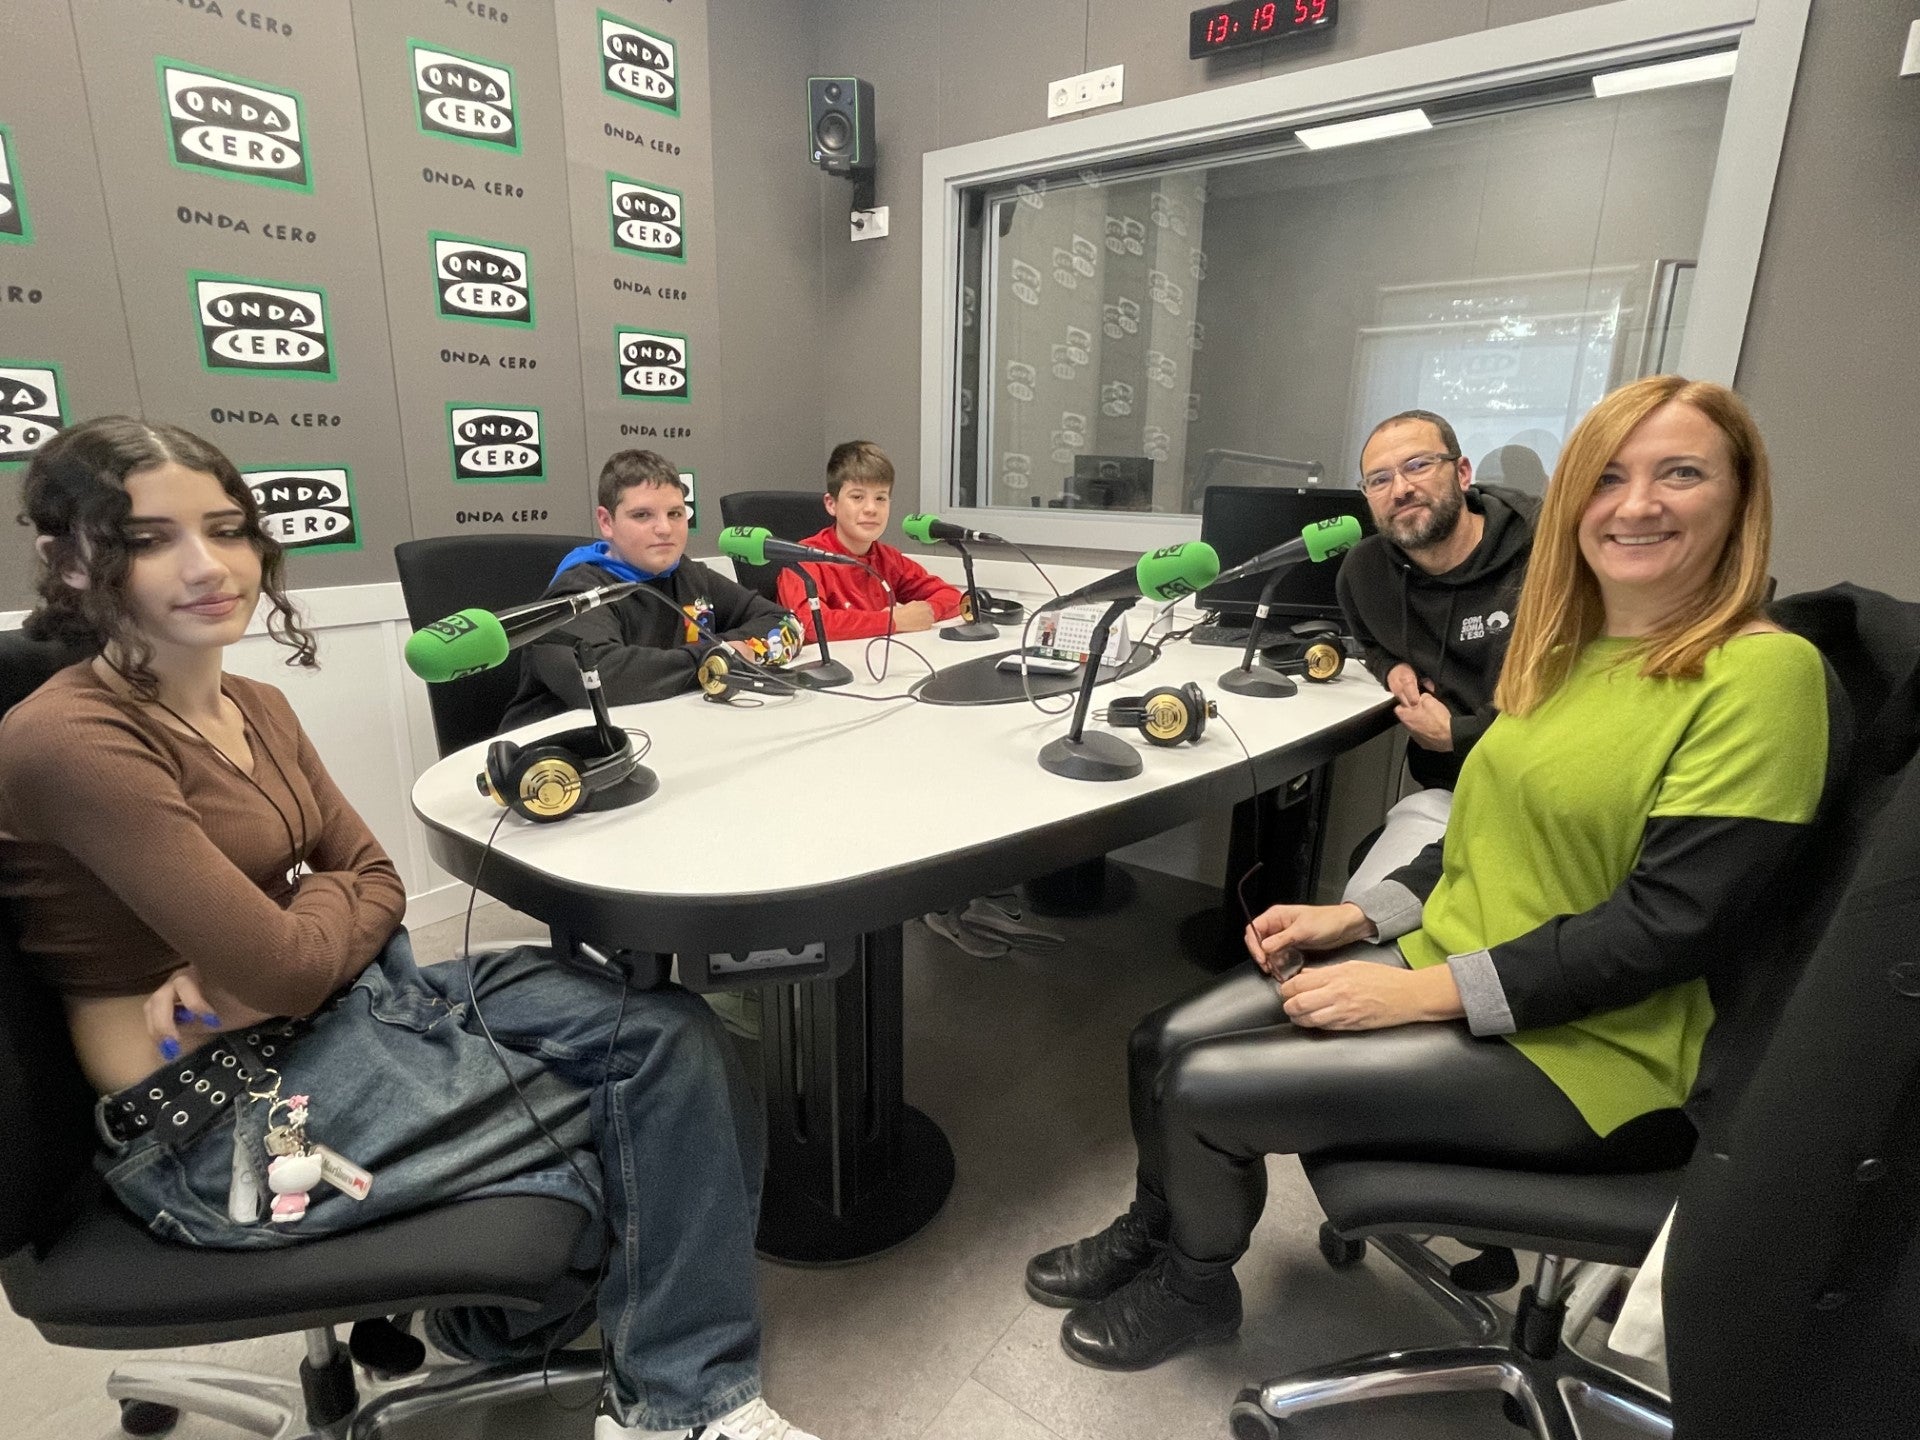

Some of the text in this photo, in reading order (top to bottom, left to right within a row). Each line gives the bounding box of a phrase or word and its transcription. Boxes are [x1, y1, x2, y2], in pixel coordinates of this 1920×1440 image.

[236, 9, 293, 37] CERO
[466, 1, 509, 24] CERO
[612, 36, 666, 67] ONDA
[429, 67, 499, 99] ONDA
[619, 66, 666, 95] CERO
[186, 91, 283, 128] ONDA
[438, 101, 501, 129] CERO
[199, 131, 286, 164] CERO
[604, 123, 681, 156] ONDA CERO
[423, 167, 524, 199] ONDA CERO
[622, 196, 672, 218] ONDA
[177, 206, 317, 243] ONDA CERO
[626, 223, 673, 245] CERO
[450, 256, 515, 278] ONDA
[0, 285, 43, 303] RO
[457, 288, 517, 307] CERO
[613, 278, 687, 301] ONDA CERO
[217, 300, 307, 323] ONDA
[229, 334, 310, 356] CERO
[628, 345, 677, 362] ONDA
[441, 349, 537, 370] ONDA CERO
[634, 370, 678, 387] CERO
[211, 408, 341, 427] ONDA CERO
[0, 425, 41, 445] RO
[465, 423, 528, 437] ONDA
[620, 424, 691, 438] ONDA CERO
[472, 450, 529, 466] CERO
[251, 486, 333, 505] ONDA
[456, 510, 548, 524] ONDA CERO
